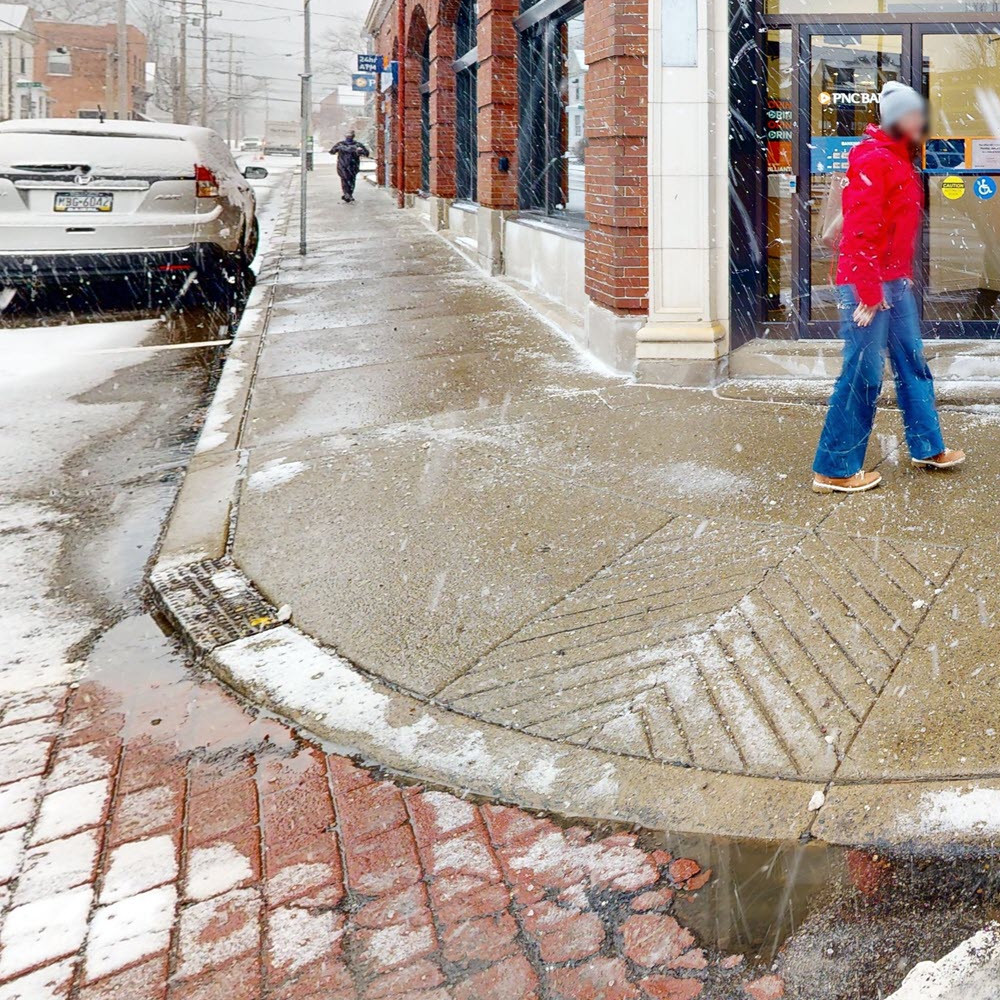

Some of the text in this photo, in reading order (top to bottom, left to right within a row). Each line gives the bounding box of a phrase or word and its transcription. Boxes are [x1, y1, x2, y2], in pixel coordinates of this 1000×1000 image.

[359, 63, 377, 71] ATM
[832, 92, 881, 104] PNC BA
